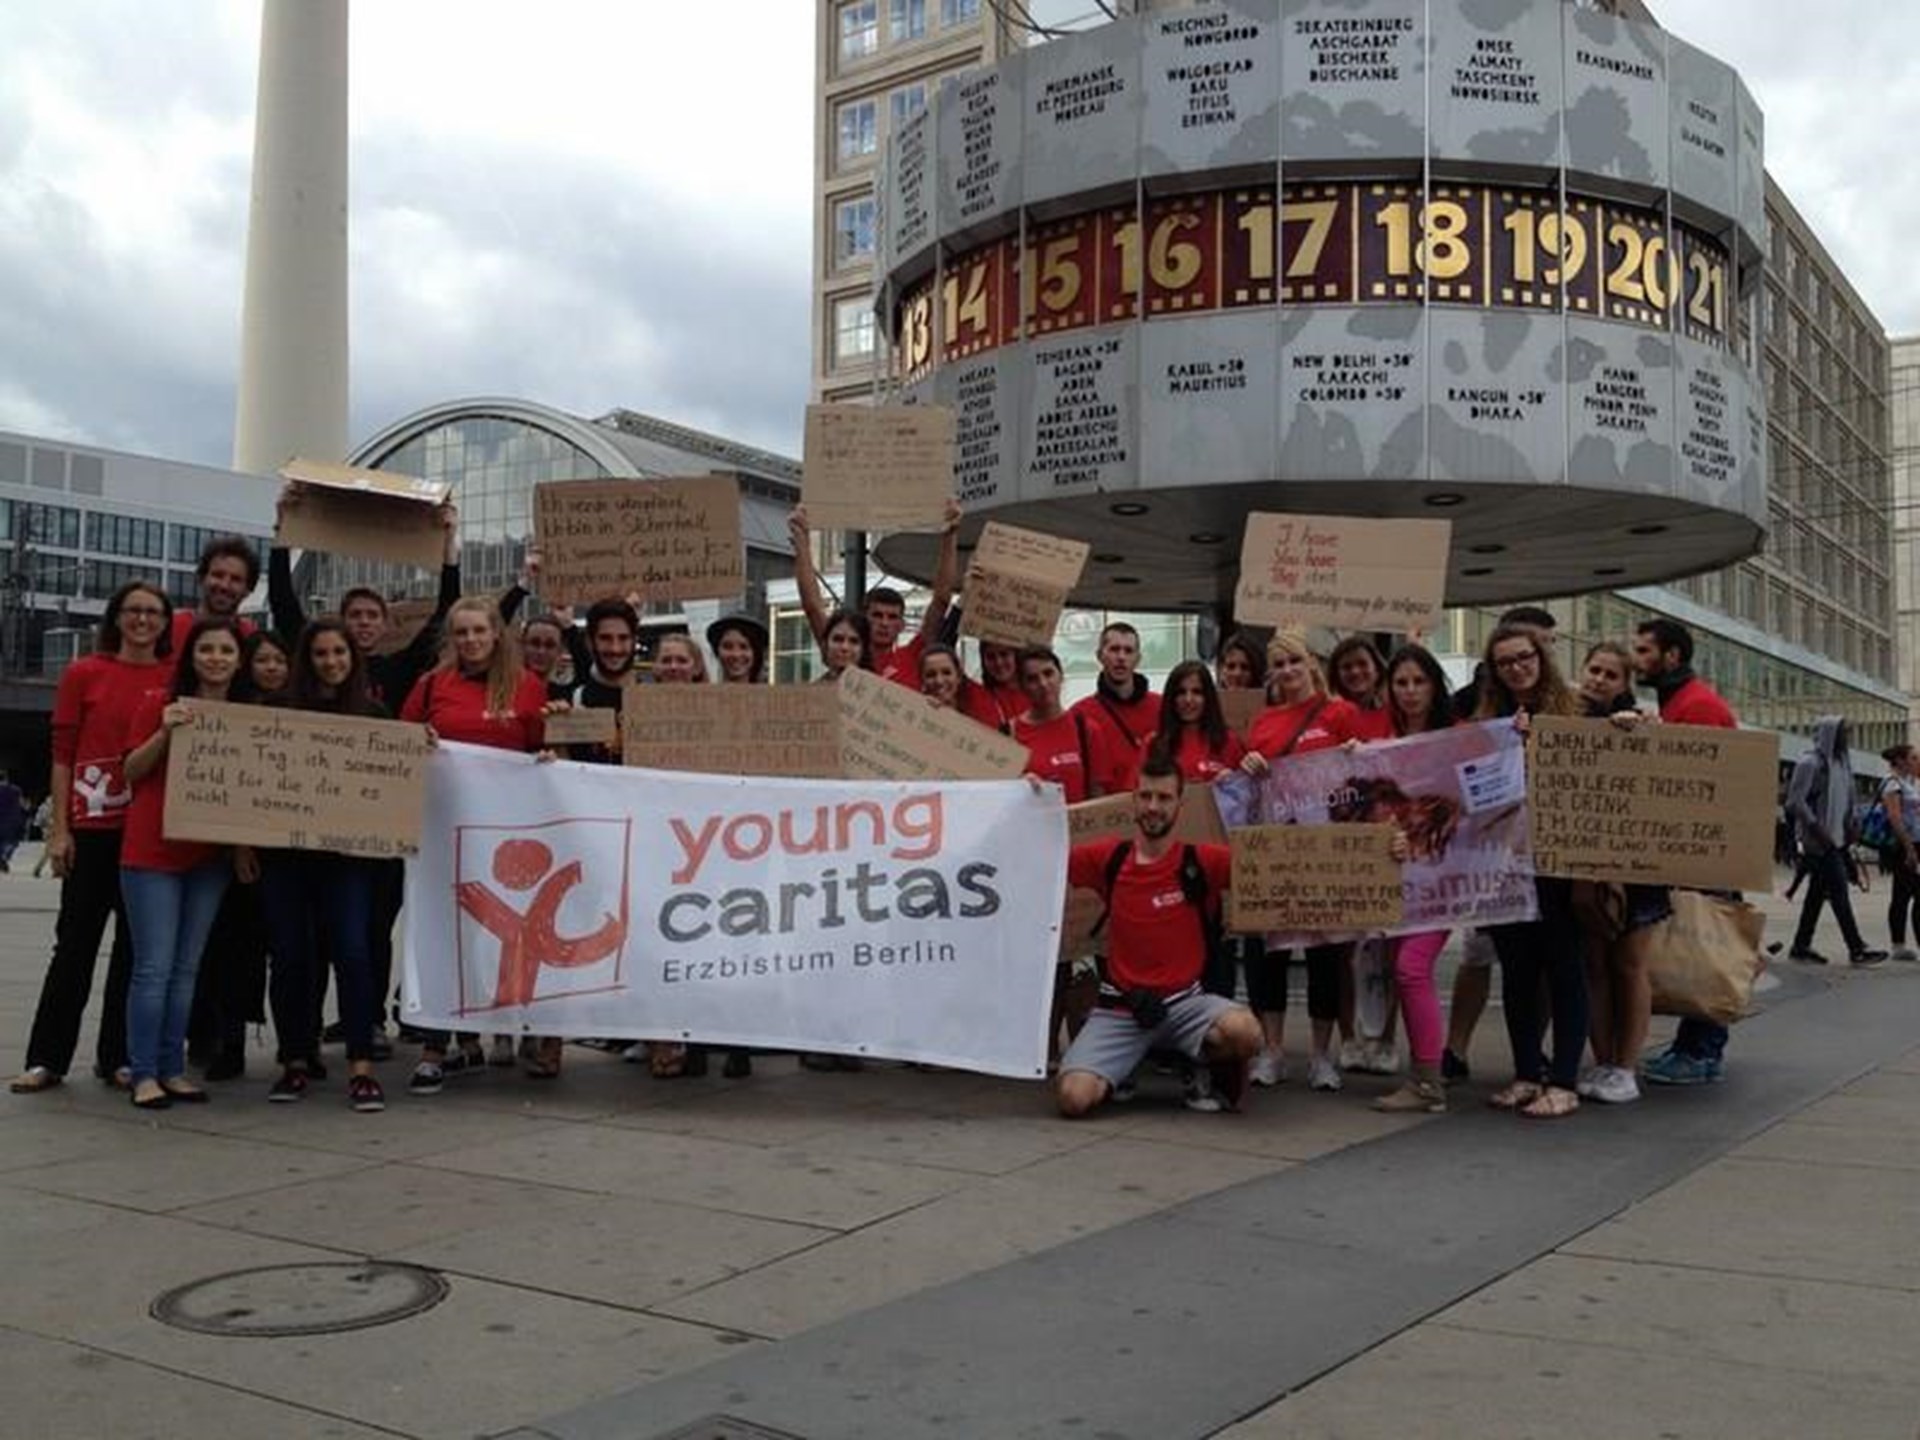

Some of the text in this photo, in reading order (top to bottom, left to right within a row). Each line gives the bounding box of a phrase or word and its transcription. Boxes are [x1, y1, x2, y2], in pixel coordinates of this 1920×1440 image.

[1184, 26, 1259, 47] NOWGOROD
[1310, 34, 1398, 49] ASCHGABAT
[1477, 39, 1513, 53] OMSK
[1319, 51, 1389, 65] BISCHKEK
[1469, 54, 1522, 70] ALMATY
[1046, 64, 1114, 96] MURMANSK
[1167, 59, 1253, 81] WOLGOGRAD
[1456, 68, 1535, 88] TASCHKENT
[1191, 79, 1228, 94] BAKU
[1451, 84, 1540, 104] NOWOSIBIRSK
[1055, 99, 1105, 125] MOSKAU
[1189, 93, 1230, 111] TIFLIS
[1182, 110, 1236, 129] ERIWAN
[1238, 201, 1337, 280] 17
[1376, 201, 1470, 279] 18
[1504, 208, 1587, 286] 19
[1113, 213, 1201, 295] 16
[1608, 223, 1679, 309] 20
[1024, 237, 1081, 316] 15
[1688, 250, 1724, 323] 21
[943, 264, 988, 344] 14
[903, 296, 931, 374] 13
[1036, 346, 1092, 365] TEHERAN
[1293, 355, 1324, 368] NEW
[1334, 354, 1376, 368] DELHI
[1054, 359, 1102, 378] BAGDAD
[1168, 362, 1214, 377] KABUL
[1317, 371, 1388, 385] KARACHI
[1603, 368, 1639, 382] HANOI
[1061, 376, 1095, 392] ADEN
[1170, 375, 1246, 393] MAURITIUS
[1300, 387, 1366, 401] COLOMBO
[1596, 381, 1646, 399] BANGKOK
[1449, 388, 1508, 403] RANGUN
[1584, 396, 1624, 413] PHNOM
[1471, 406, 1524, 420] DHAKA
[250, 714, 294, 743] sehe
[309, 729, 355, 749] meine
[188, 736, 241, 764] jeden
[305, 750, 330, 770] ich
[1537, 730, 1585, 750] WHEN
[1658, 740, 1721, 761] HUNGRY
[1570, 751, 1598, 768] EAT
[185, 766, 225, 785] Geld
[185, 788, 229, 807] nicht
[1535, 772, 1580, 790] WHEN
[1648, 777, 1717, 803] THIRSTY
[1571, 793, 1632, 815] DRINK
[1574, 815, 1685, 839] COLLECTING
[668, 791, 944, 884] young
[657, 861, 1003, 943] caritas
[663, 940, 957, 984] Erzbistum Berlin
